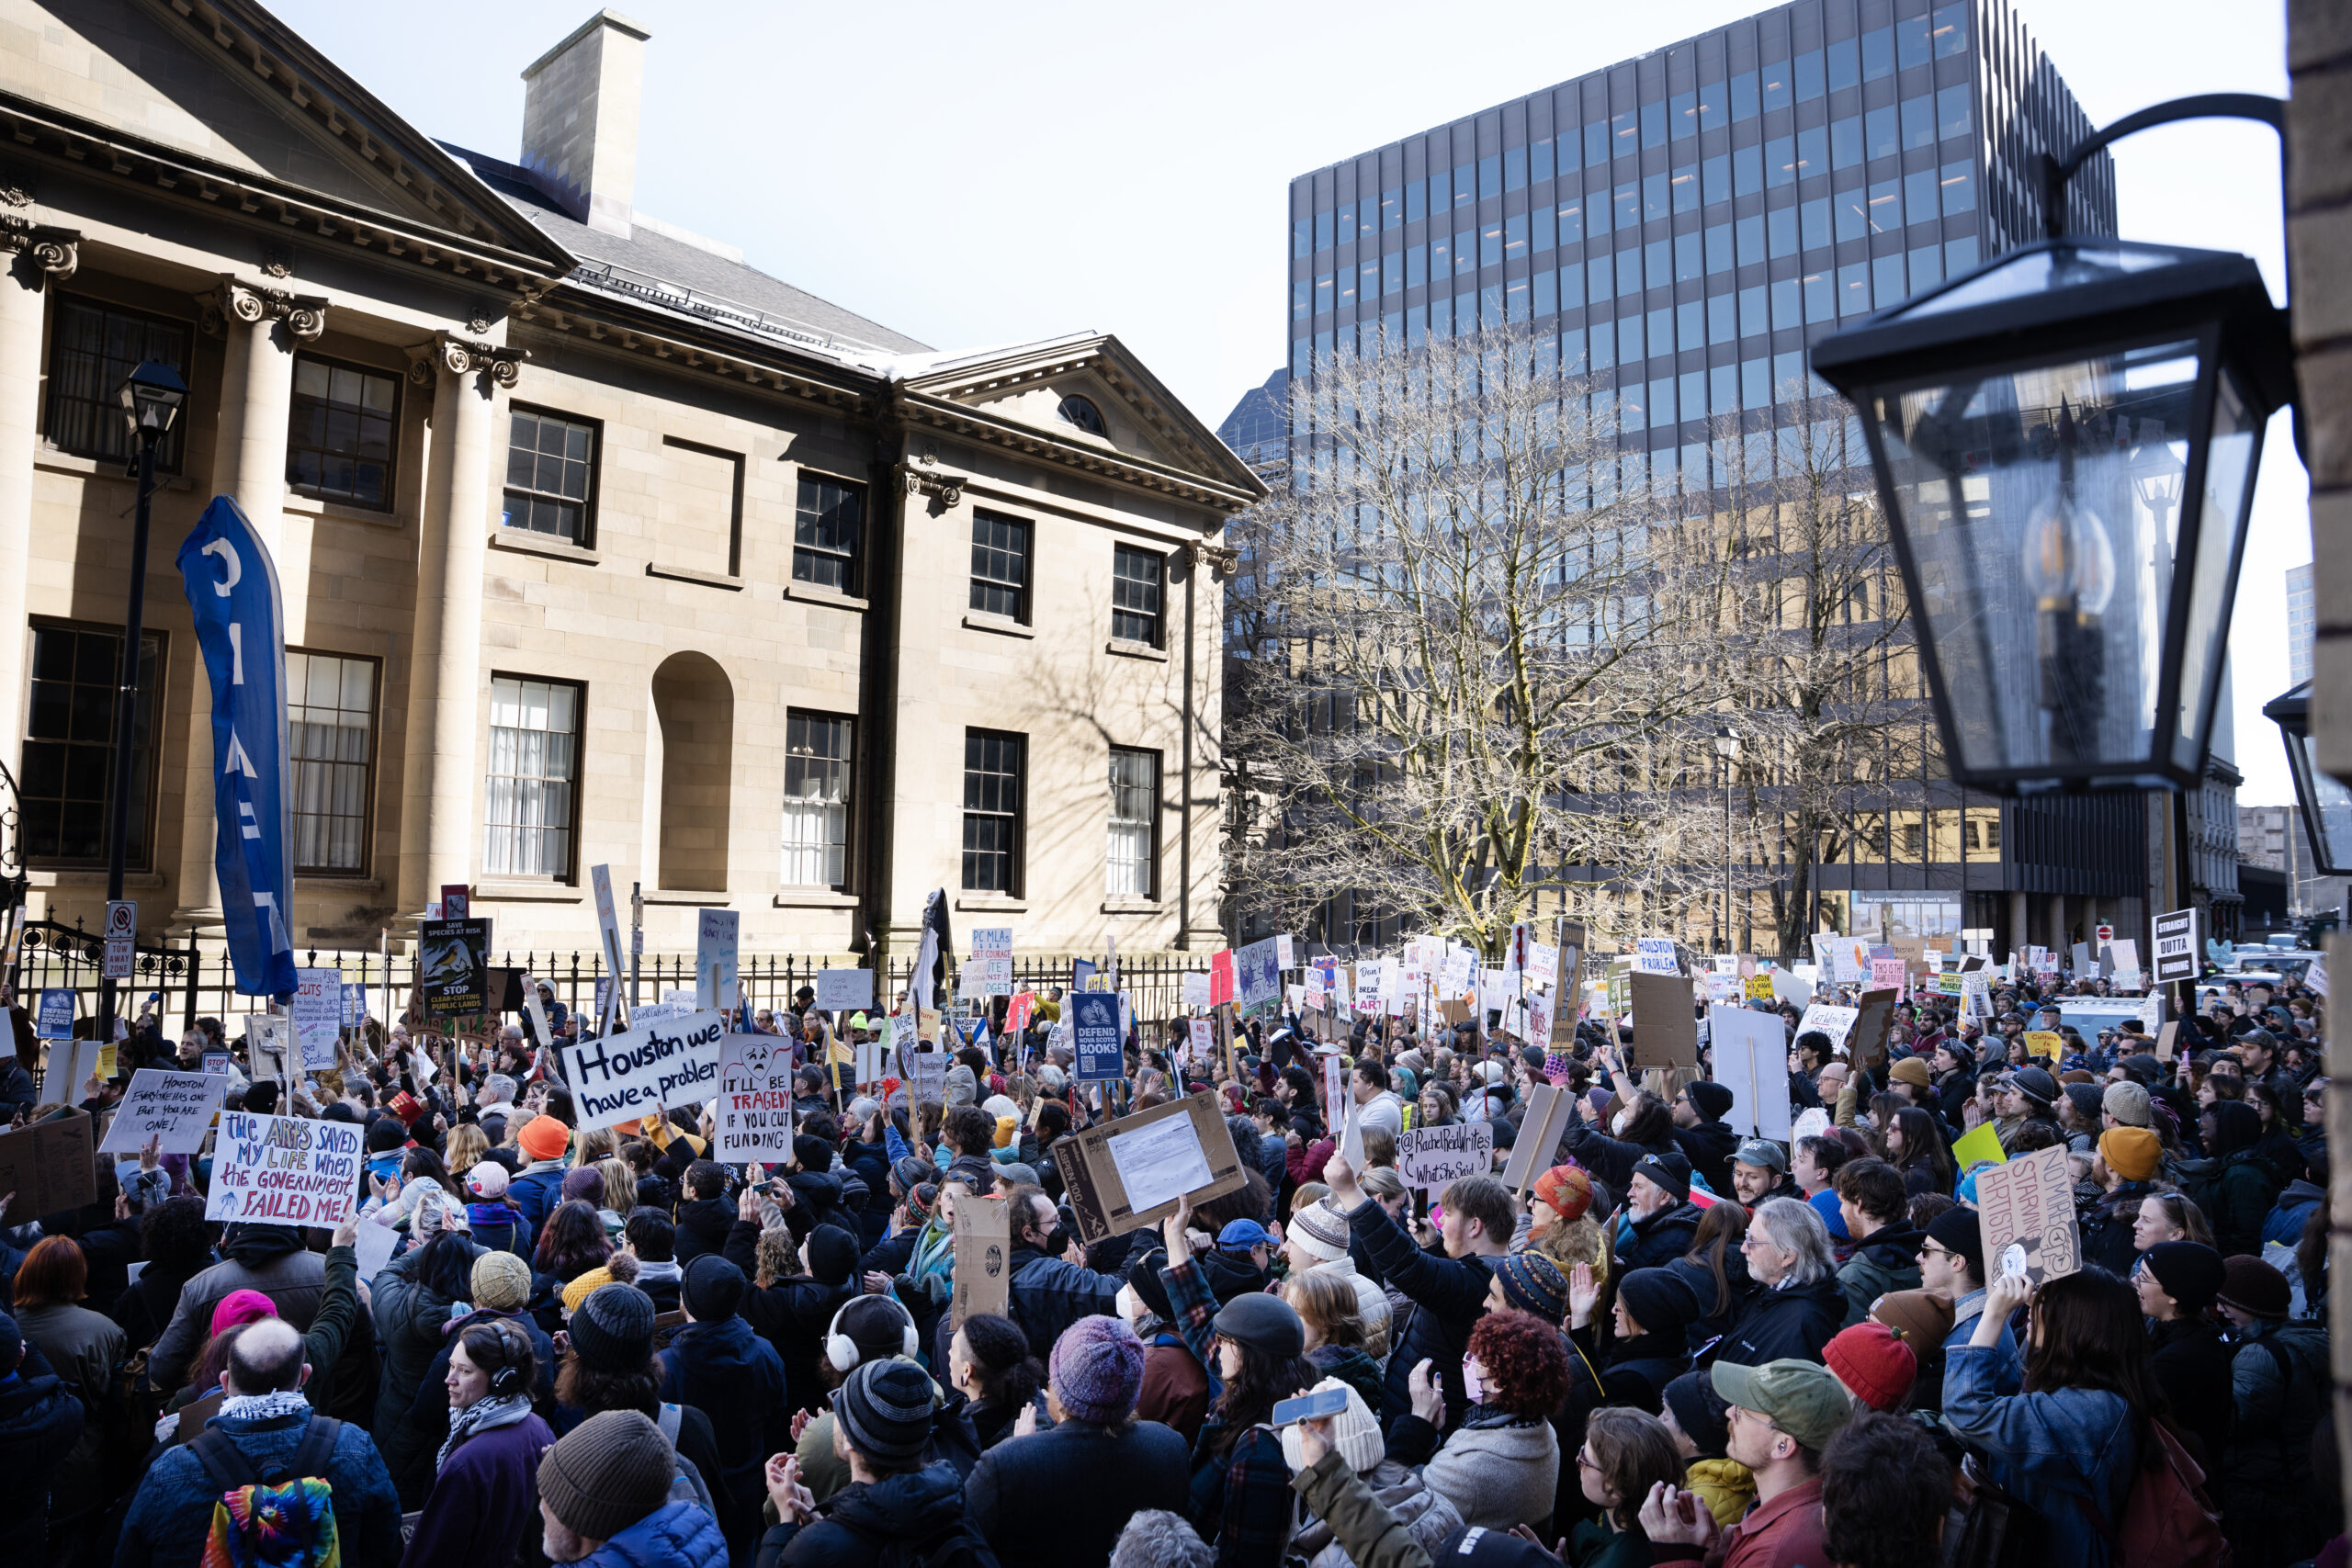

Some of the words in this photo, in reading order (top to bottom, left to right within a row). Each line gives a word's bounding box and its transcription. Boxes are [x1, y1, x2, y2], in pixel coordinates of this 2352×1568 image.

[2158, 917, 2188, 933] STRAIGHT
[974, 930, 984, 943] PC
[987, 930, 1011, 943] MLAs
[112, 945, 128, 953] TOW
[1637, 941, 1673, 953] HOUSTON
[2160, 938, 2187, 953] OUTTA
[973, 950, 983, 959] GET
[985, 950, 1011, 959] COURAGE
[1240, 941, 1272, 968] ENOUGH
[1542, 956, 1549, 964] IS
[110, 964, 128, 973] ZONE
[987, 962, 1001, 973] OTE
[1642, 957, 1675, 971] PROBLEM
[1875, 964, 1887, 974] THIS
[1889, 964, 1893, 974] IS
[1894, 964, 1904, 974] THE
[2161, 960, 2189, 974] FUNDING
[323, 970, 340, 984] $309
[1251, 966, 1264, 984] IS
[1360, 966, 1381, 977] Don't
[297, 984, 322, 997] CUTS
[443, 986, 469, 996] STOP
[987, 983, 1010, 993] DGET
[1244, 981, 1279, 1005] ENOUGH
[431, 994, 480, 1003] CLEAR-CUTTING
[432, 1001, 458, 1010] PUBLIC
[458, 999, 481, 1009] LANDS
[1567, 1008, 1576, 1021] NOT
[1824, 1010, 1839, 1025] WITH
[1838, 1013, 1849, 1026] THE
[1079, 1028, 1115, 1037] DEFEND
[1196, 1024, 1205, 1033] NO
[1553, 1027, 1573, 1043] DISTURB
[2032, 1033, 2057, 1042] Culture
[301, 1044, 314, 1053] ova
[576, 1030, 684, 1085] Houston
[686, 1023, 722, 1047] we
[1080, 1043, 1117, 1055] BOOKS
[303, 1051, 336, 1067] Scotians!
[919, 1062, 943, 1070] Budget
[722, 1077, 758, 1093] IT'LL
[769, 1075, 786, 1089] BE
[919, 1077, 937, 1085] many
[172, 1091, 187, 1101] HAS
[581, 1089, 643, 1118] have
[642, 1084, 658, 1099] a
[731, 1089, 790, 1111] TRAGEDY
[180, 1106, 200, 1115] ARE
[145, 1117, 178, 1132] ONE!
[727, 1113, 735, 1128] IF
[744, 1113, 766, 1131] YOU
[770, 1111, 789, 1128] CUT
[316, 1125, 358, 1155] SAVED
[724, 1131, 784, 1150] FUNDING
[237, 1142, 265, 1167] MY
[266, 1147, 309, 1170] LIFE
[2040, 1148, 2066, 1182] NO
[1058, 1147, 1077, 1181] ASPEN
[1069, 1180, 1083, 1202] 100
[2012, 1161, 2042, 1240] STARVING
[2044, 1181, 2073, 1224] MORE
[313, 1194, 353, 1224] ME!
[1983, 1171, 2014, 1247] ARTISTS
